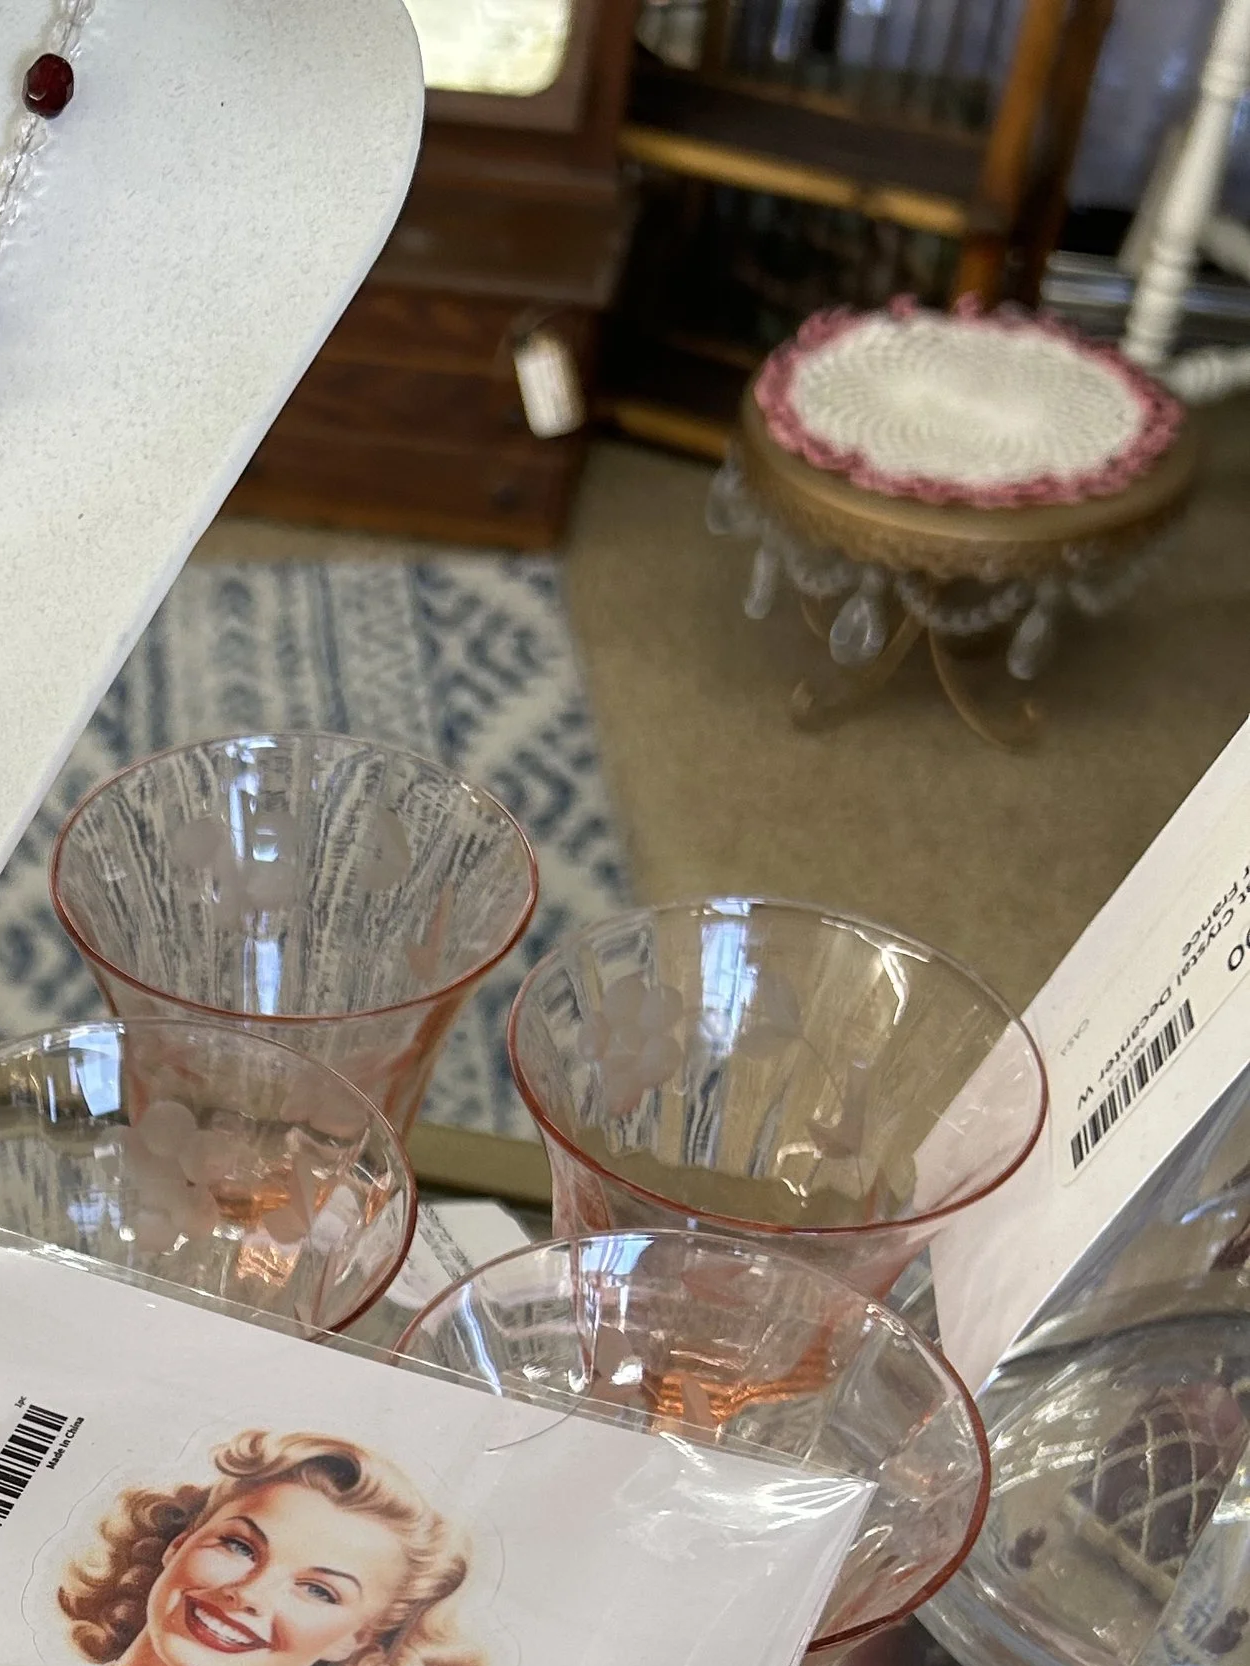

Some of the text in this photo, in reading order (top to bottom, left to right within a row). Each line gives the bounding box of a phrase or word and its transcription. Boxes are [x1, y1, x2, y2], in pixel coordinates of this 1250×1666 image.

[1176, 907, 1235, 987] Crystal
[1182, 881, 1238, 956] France
[1097, 985, 1173, 1082] Decanter
[1076, 1085, 1094, 1111] W
[45, 1448, 65, 1470] Made
[65, 1416, 85, 1439] China
